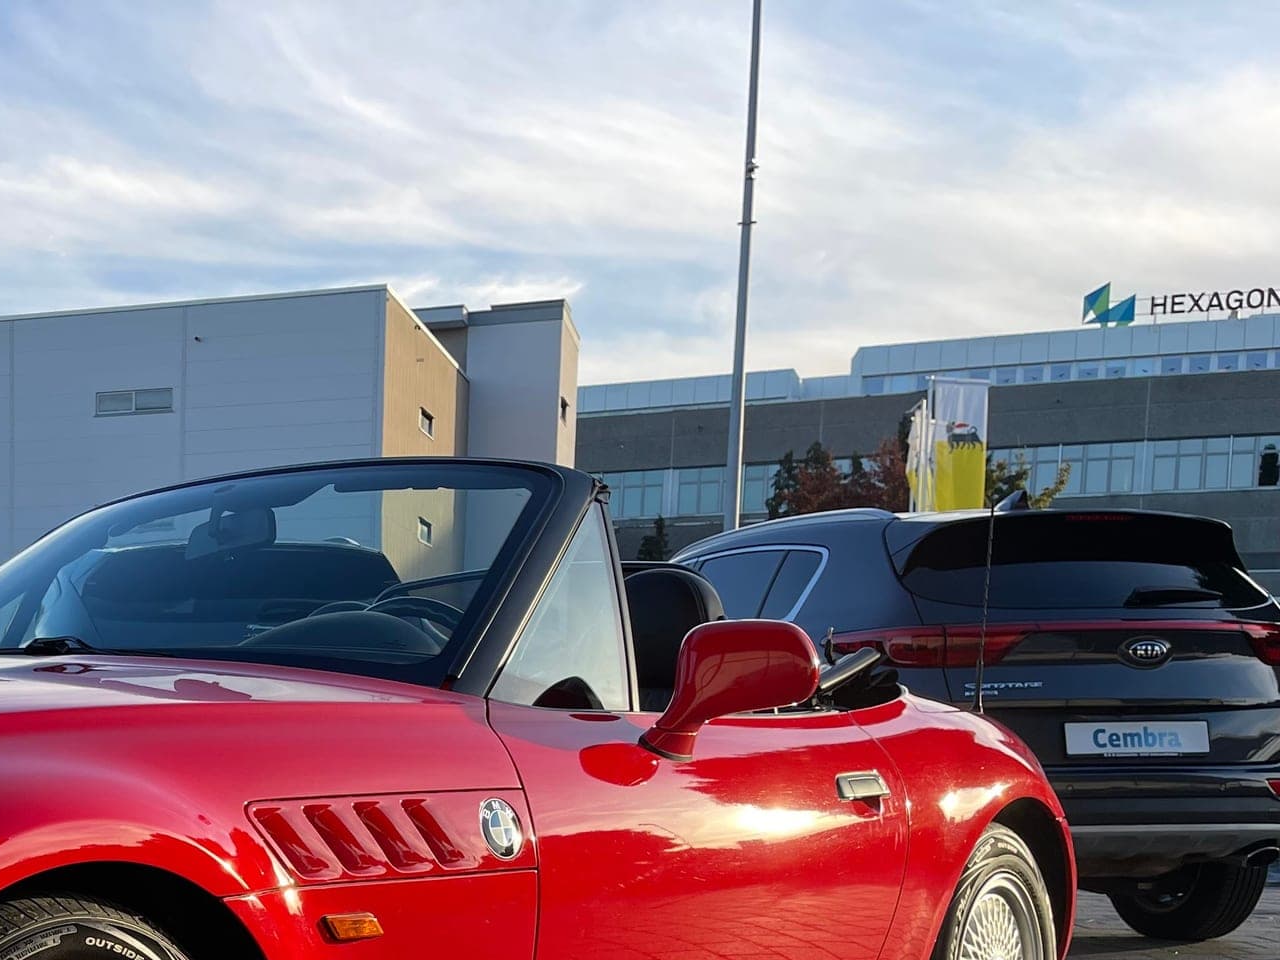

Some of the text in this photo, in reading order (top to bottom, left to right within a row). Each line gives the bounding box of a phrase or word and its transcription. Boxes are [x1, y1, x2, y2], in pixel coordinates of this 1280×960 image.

[1150, 287, 1280, 315] HEXAGON
[1136, 645, 1161, 657] KIA
[1092, 726, 1182, 748] Cembra
